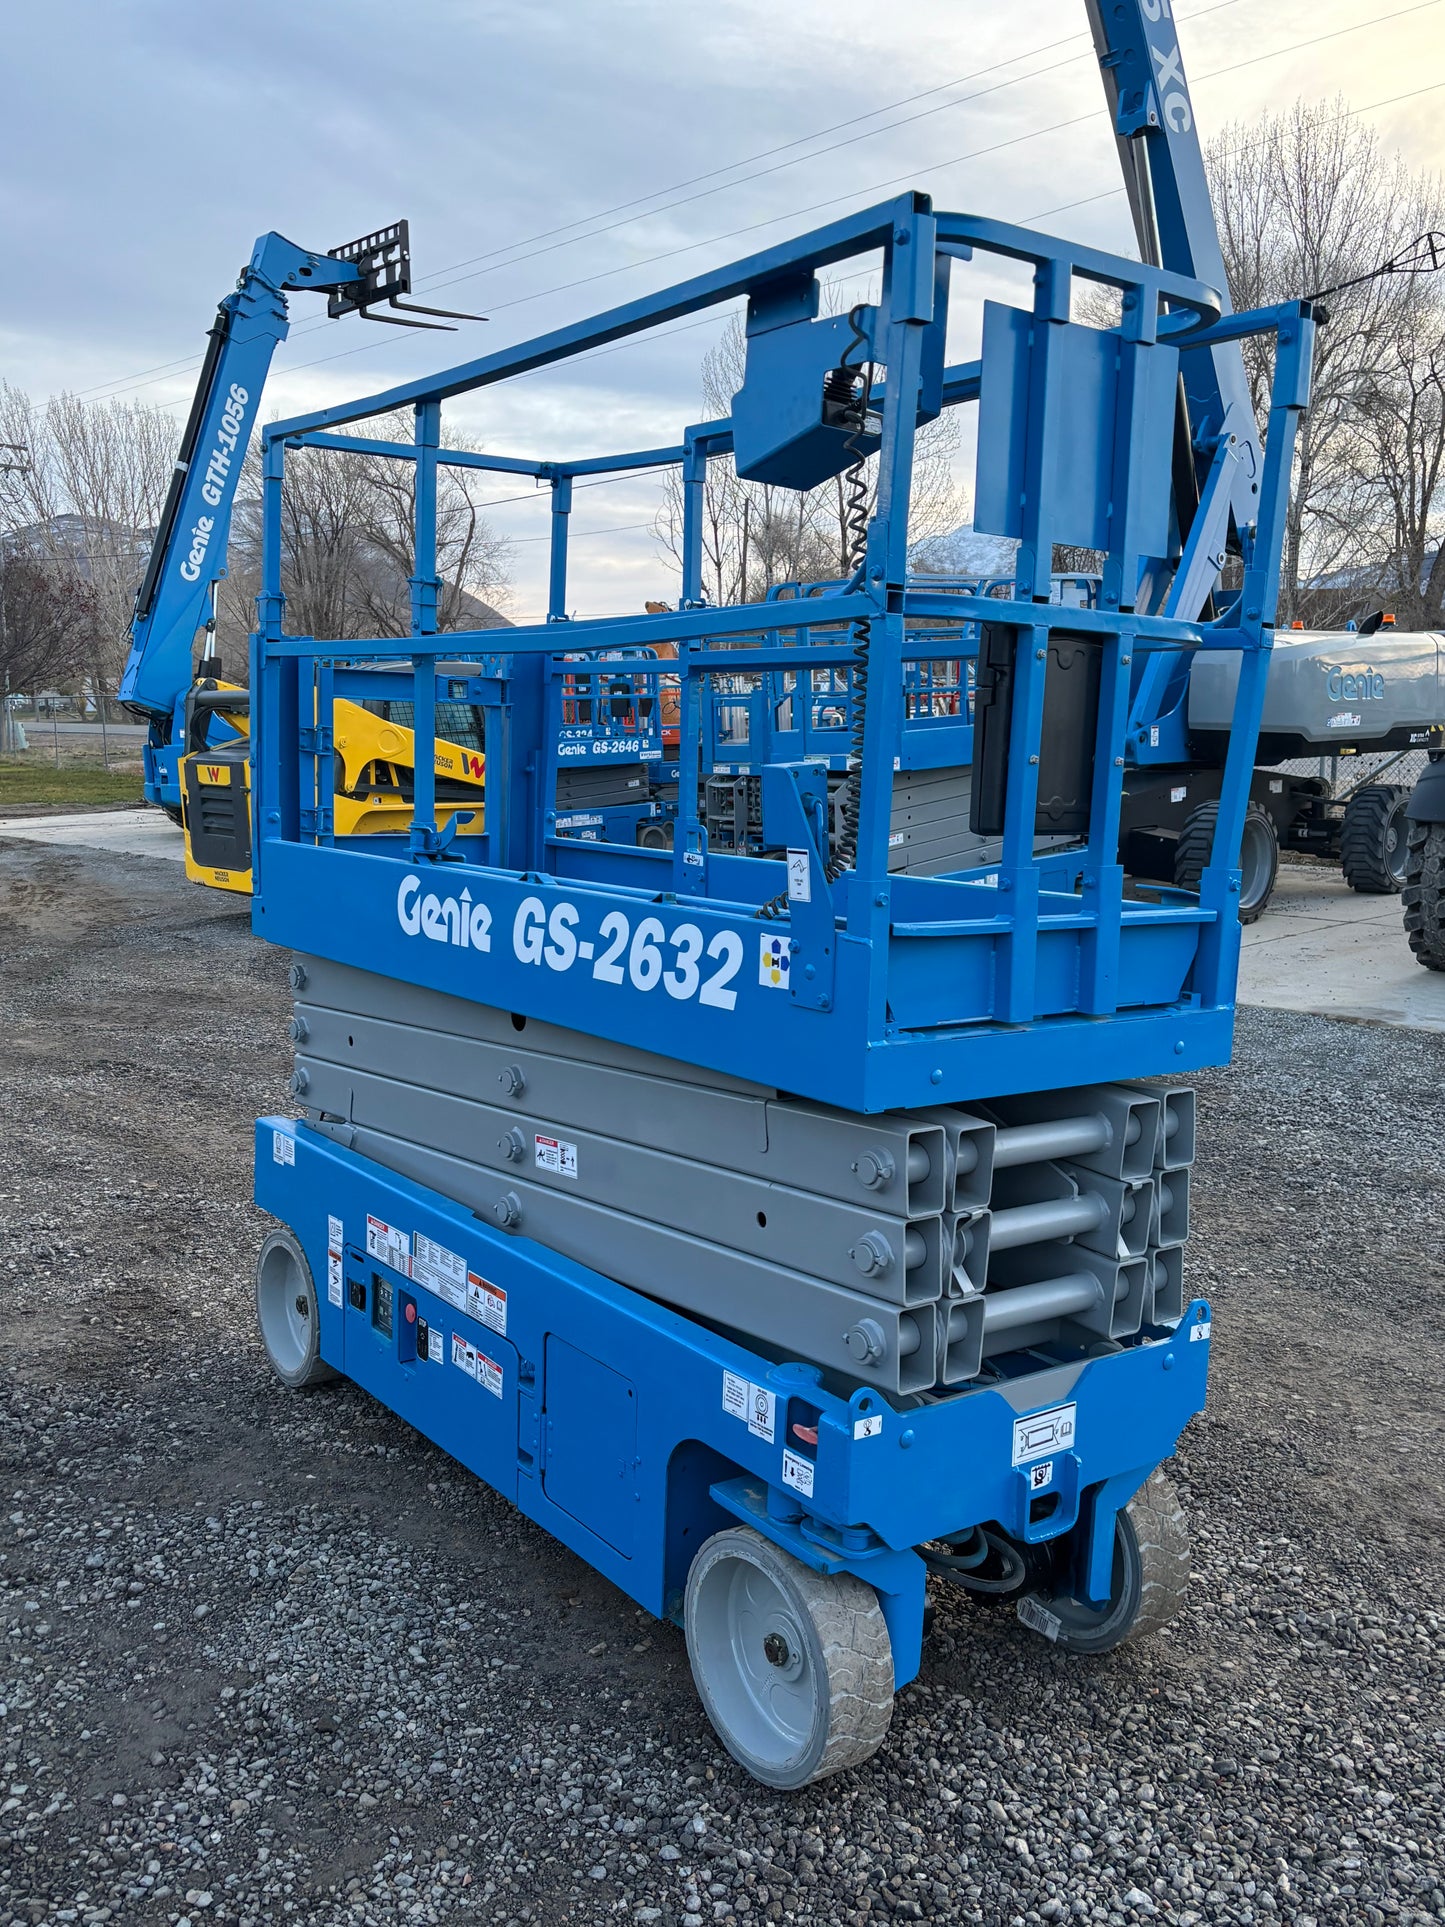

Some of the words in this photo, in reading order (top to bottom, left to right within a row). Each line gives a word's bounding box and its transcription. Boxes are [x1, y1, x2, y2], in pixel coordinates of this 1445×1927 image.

[1151, 43, 1192, 134] XC
[180, 515, 214, 582] Genie
[202, 383, 249, 506] GTH-1056
[1326, 666, 1385, 701] Genie
[558, 743, 587, 755] Genie
[592, 741, 639, 754] GS-2646
[397, 874, 492, 953] Genie
[513, 897, 744, 1011] GS-2632
